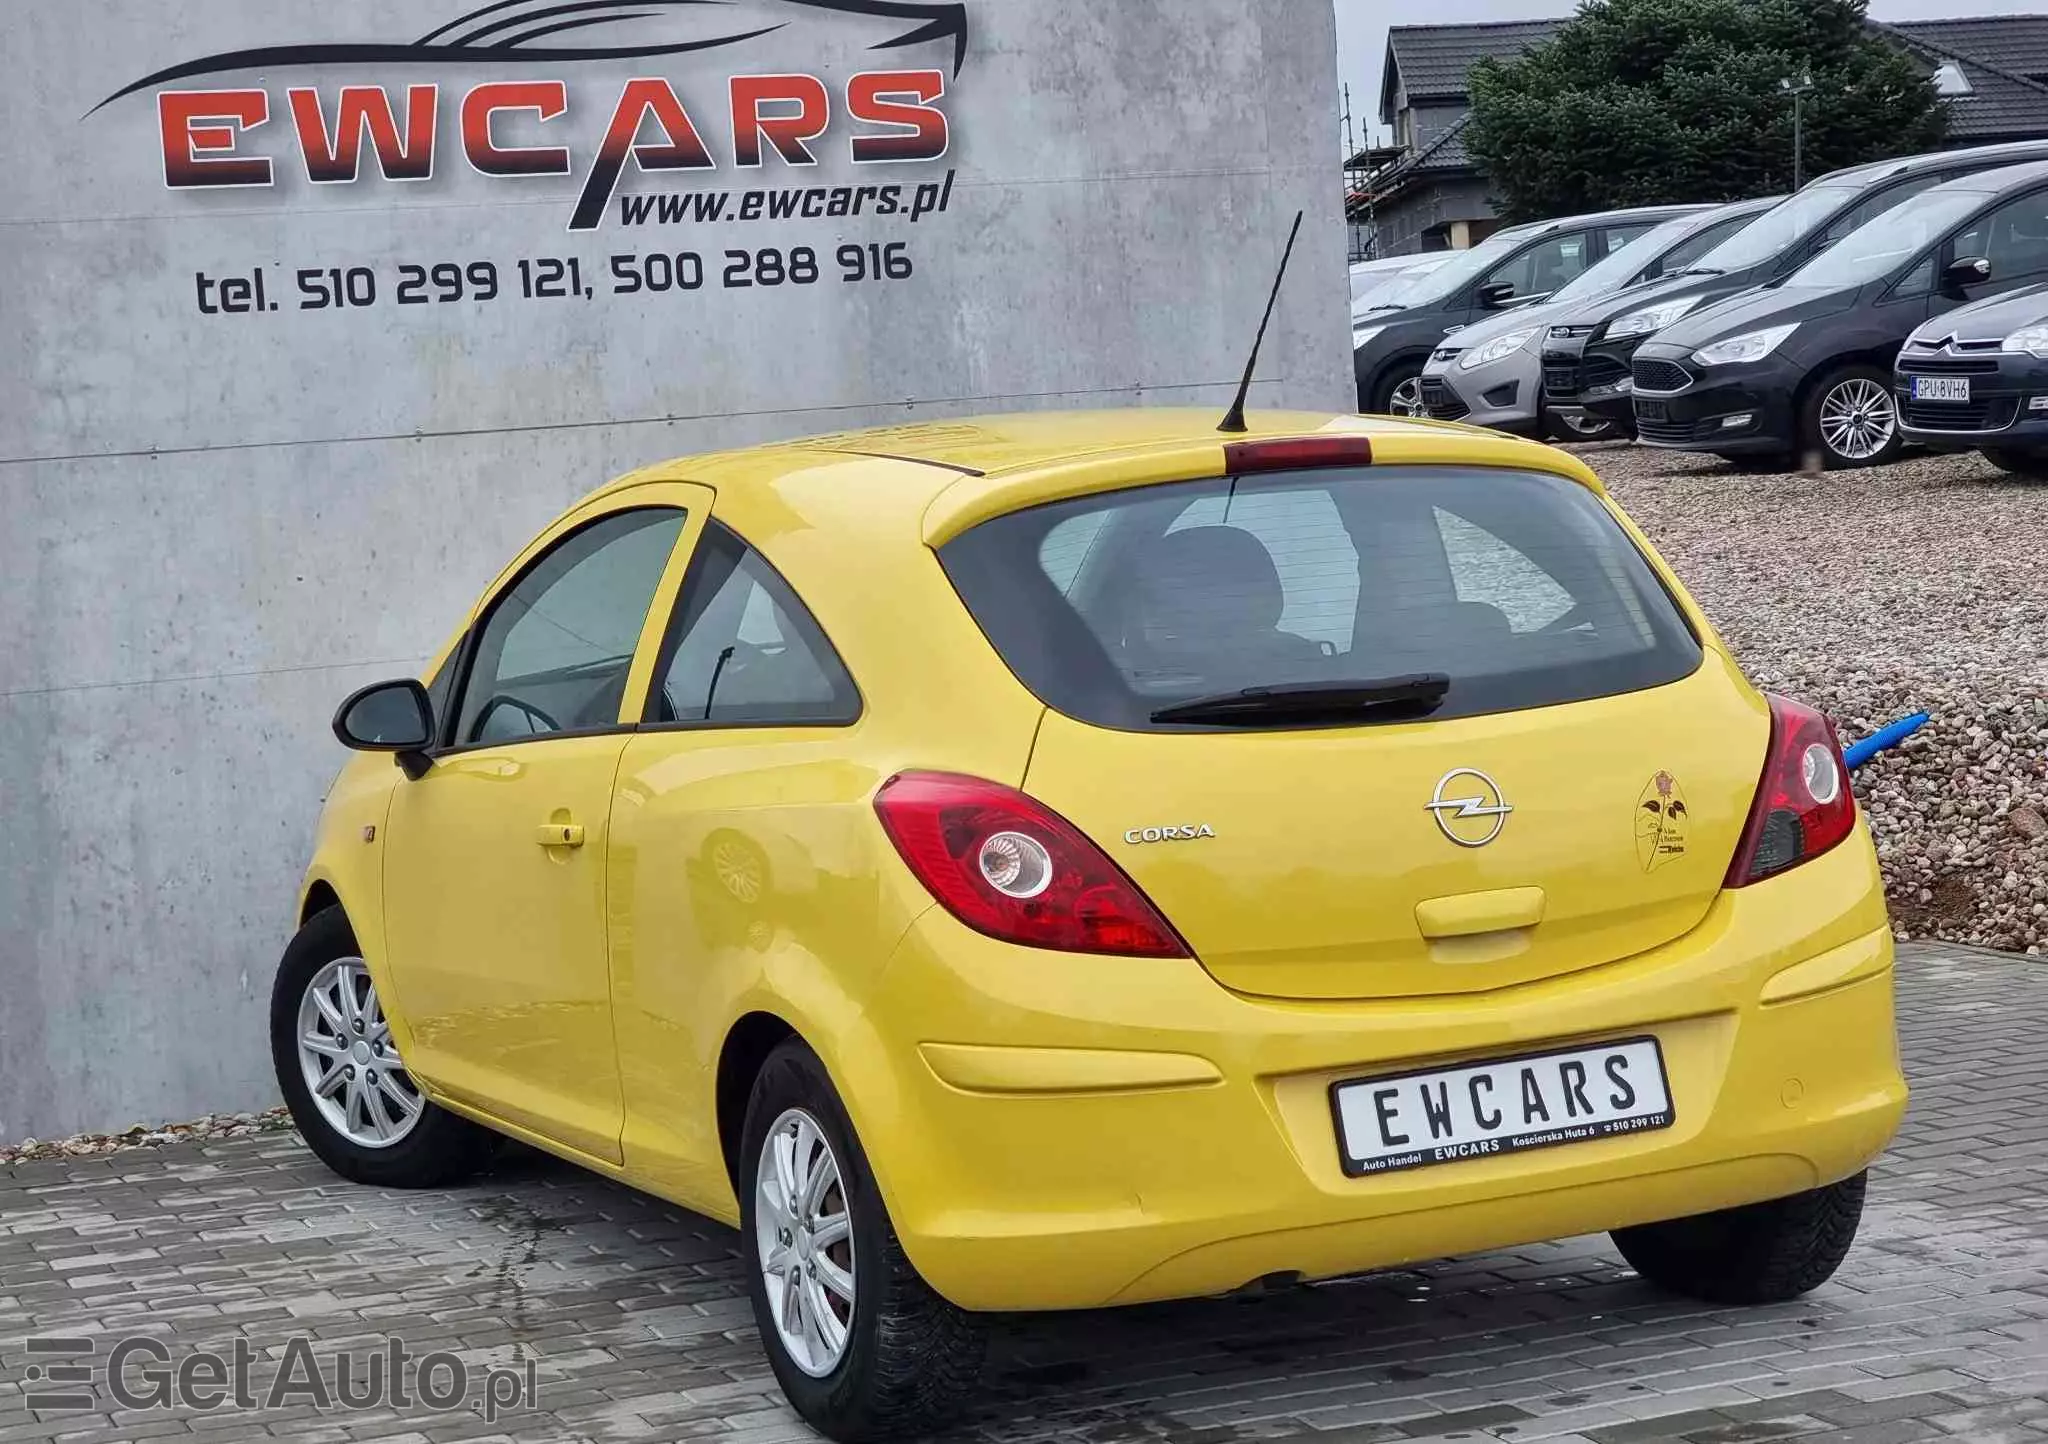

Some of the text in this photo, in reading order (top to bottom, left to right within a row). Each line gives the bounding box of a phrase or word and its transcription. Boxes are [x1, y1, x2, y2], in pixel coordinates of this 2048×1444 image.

[157, 69, 951, 232] EWCARS
[619, 170, 956, 227] www.ewcars.pl
[196, 242, 912, 314] tel. 510 299 121, 500 288 916
[1918, 379, 1937, 397] GPU
[1124, 823, 1217, 844] CORSA
[1373, 1054, 1636, 1147] EWCARS
[1363, 1160, 1386, 1171] Auto
[1387, 1153, 1422, 1168] Handel
[1434, 1139, 1500, 1161] EWCARS
[1565, 1128, 1587, 1139] Huta
[1589, 1126, 1595, 1136] 6
[1613, 1121, 1629, 1132] 510
[1631, 1118, 1648, 1129] 299
[1650, 1114, 1665, 1125] 121
